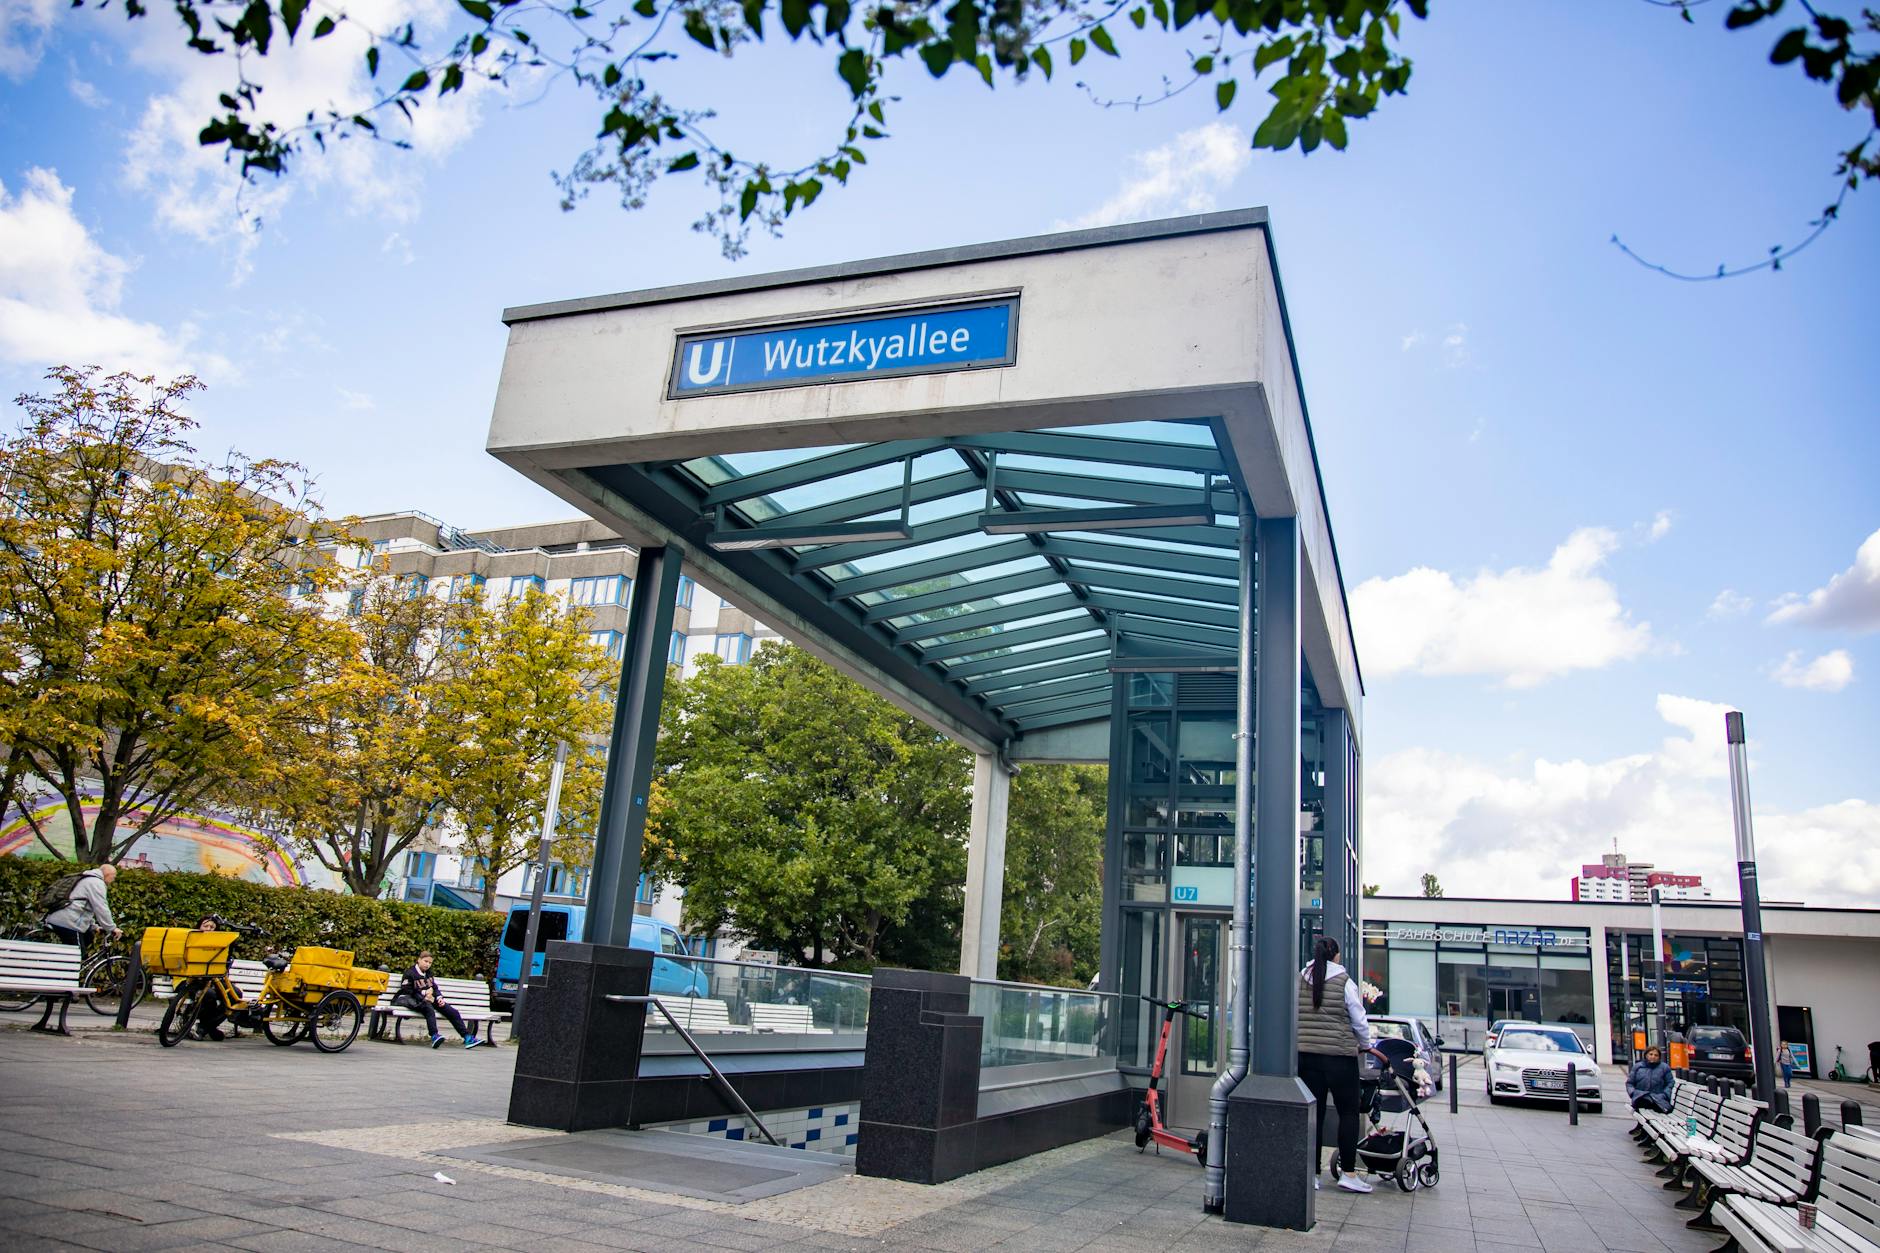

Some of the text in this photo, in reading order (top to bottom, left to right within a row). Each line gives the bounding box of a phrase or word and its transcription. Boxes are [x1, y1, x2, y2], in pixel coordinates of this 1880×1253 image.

[687, 322, 971, 385] U Wutzkyallee
[1177, 887, 1196, 900] U7
[1396, 928, 1492, 943] FAHRSCHULE
